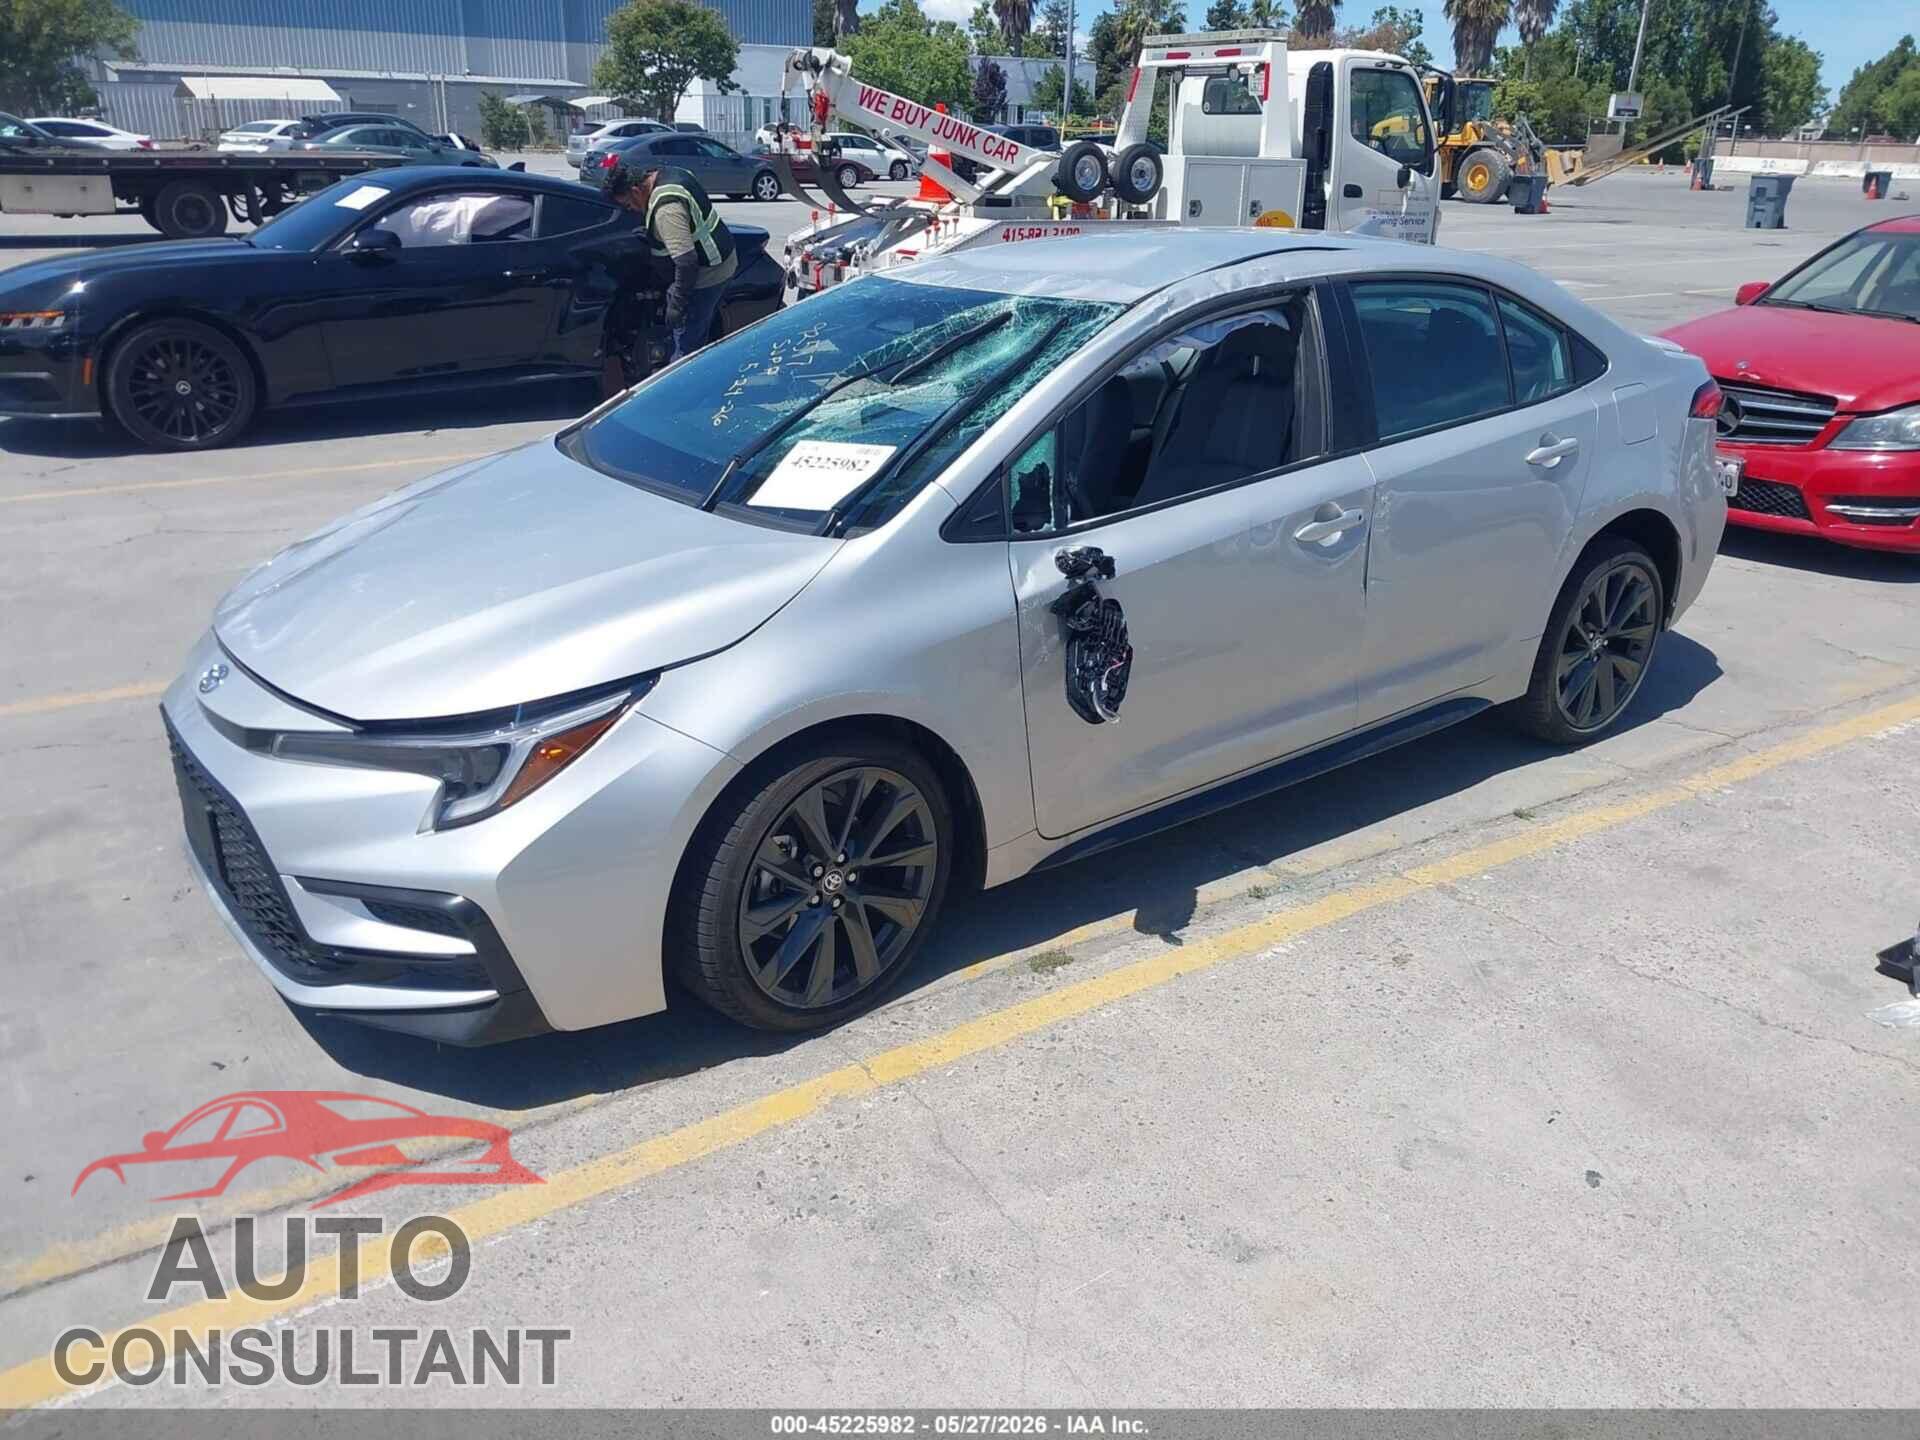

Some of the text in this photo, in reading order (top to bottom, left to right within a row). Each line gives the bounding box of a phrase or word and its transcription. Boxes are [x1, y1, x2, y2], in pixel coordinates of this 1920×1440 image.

[858, 85, 1019, 164] WE BUY JUNK CAR
[1400, 214, 1425, 225] Service
[791, 455, 870, 472] 45225982
